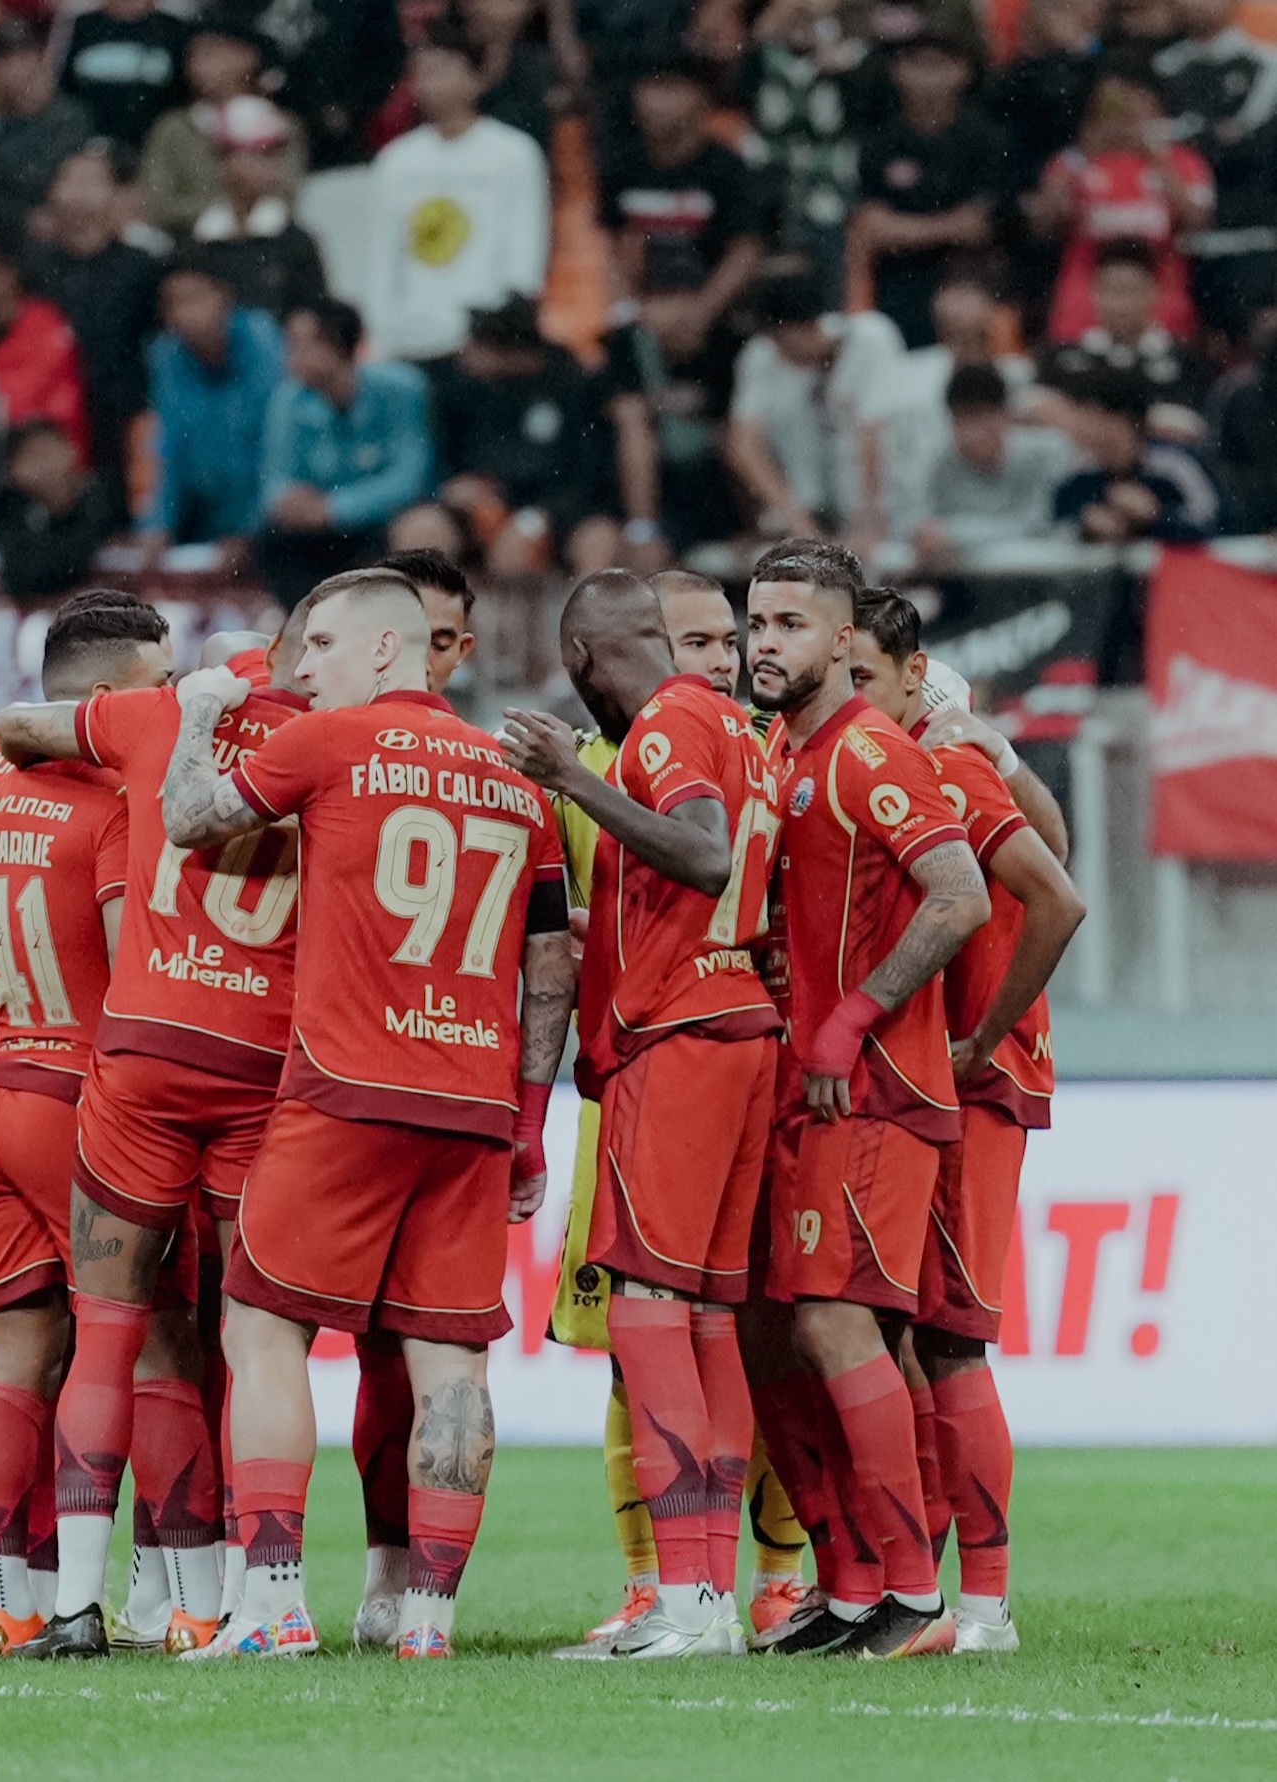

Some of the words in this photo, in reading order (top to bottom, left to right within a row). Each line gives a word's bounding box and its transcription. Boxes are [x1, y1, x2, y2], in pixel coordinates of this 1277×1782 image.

[425, 735, 522, 776] HYUND
[351, 754, 430, 797] FÁBIO
[437, 770, 545, 829] CALONEGO
[964, 808, 982, 830] zme
[374, 804, 530, 980] 97
[187, 934, 224, 967] Le
[148, 948, 270, 997] Minerale
[425, 983, 457, 1018] Le
[385, 1005, 500, 1049] Minerale
[572, 1293, 601, 1308] TCT
